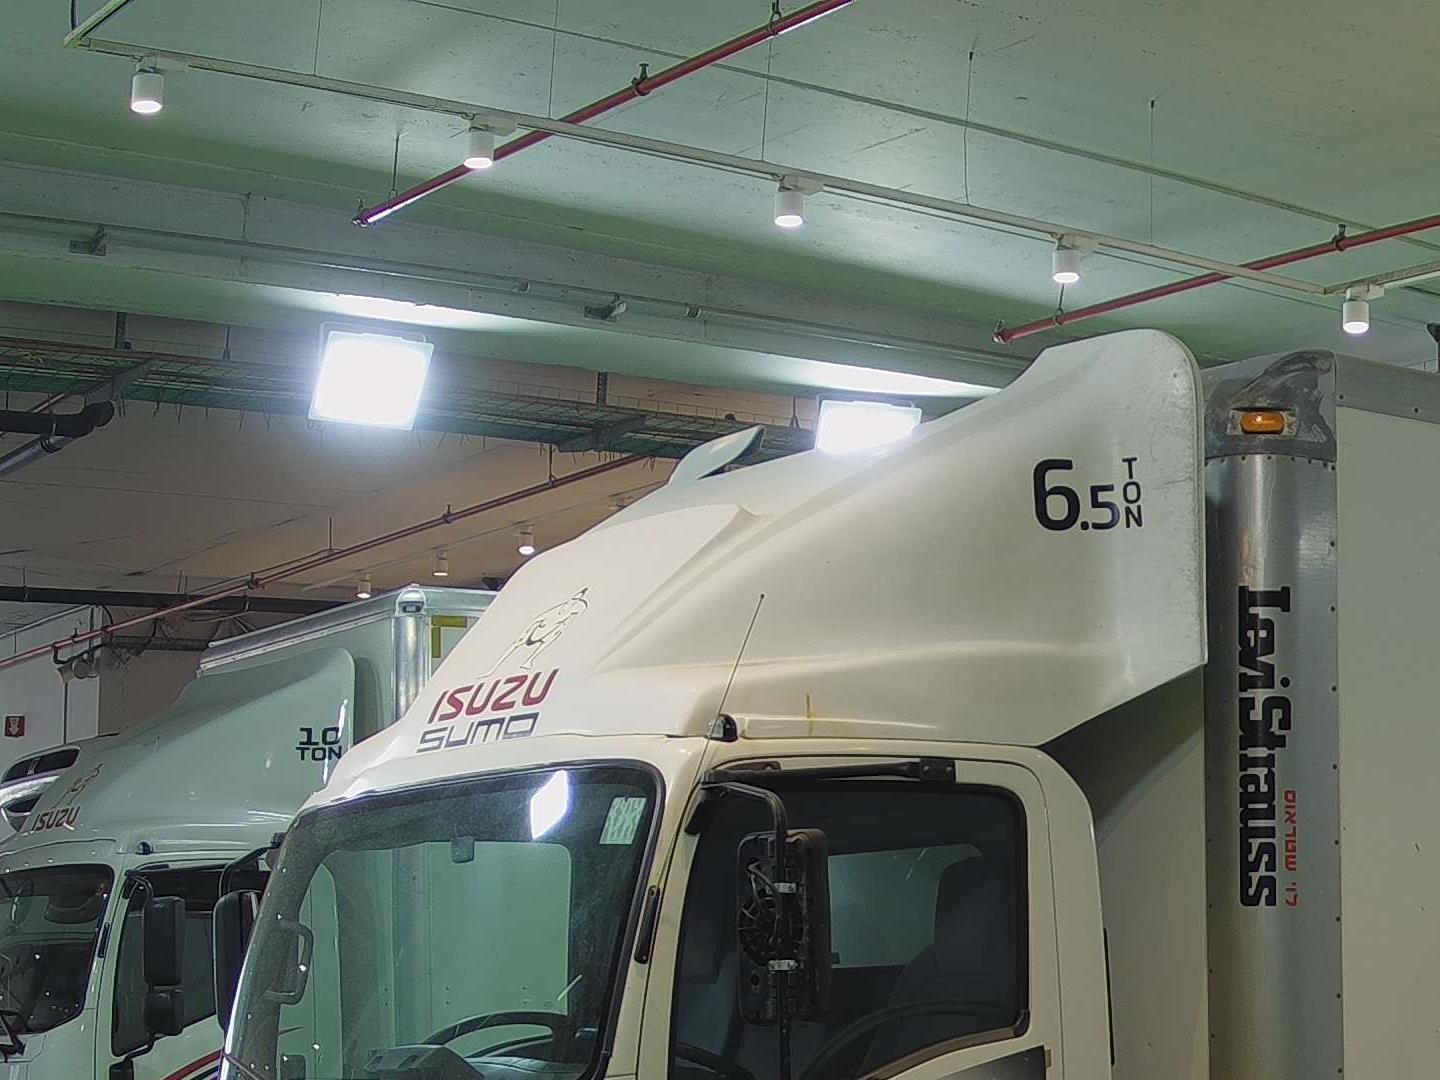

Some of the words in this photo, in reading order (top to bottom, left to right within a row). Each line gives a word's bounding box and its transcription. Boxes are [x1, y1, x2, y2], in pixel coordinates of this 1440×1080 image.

[1033, 459, 1120, 531] 6.5
[1121, 457, 1143, 529] TON
[428, 668, 559, 724] ISUZU
[295, 745, 343, 761] TON
[299, 726, 341, 746] 10
[415, 712, 540, 753] SUMO
[31, 806, 81, 831] ISUZU
